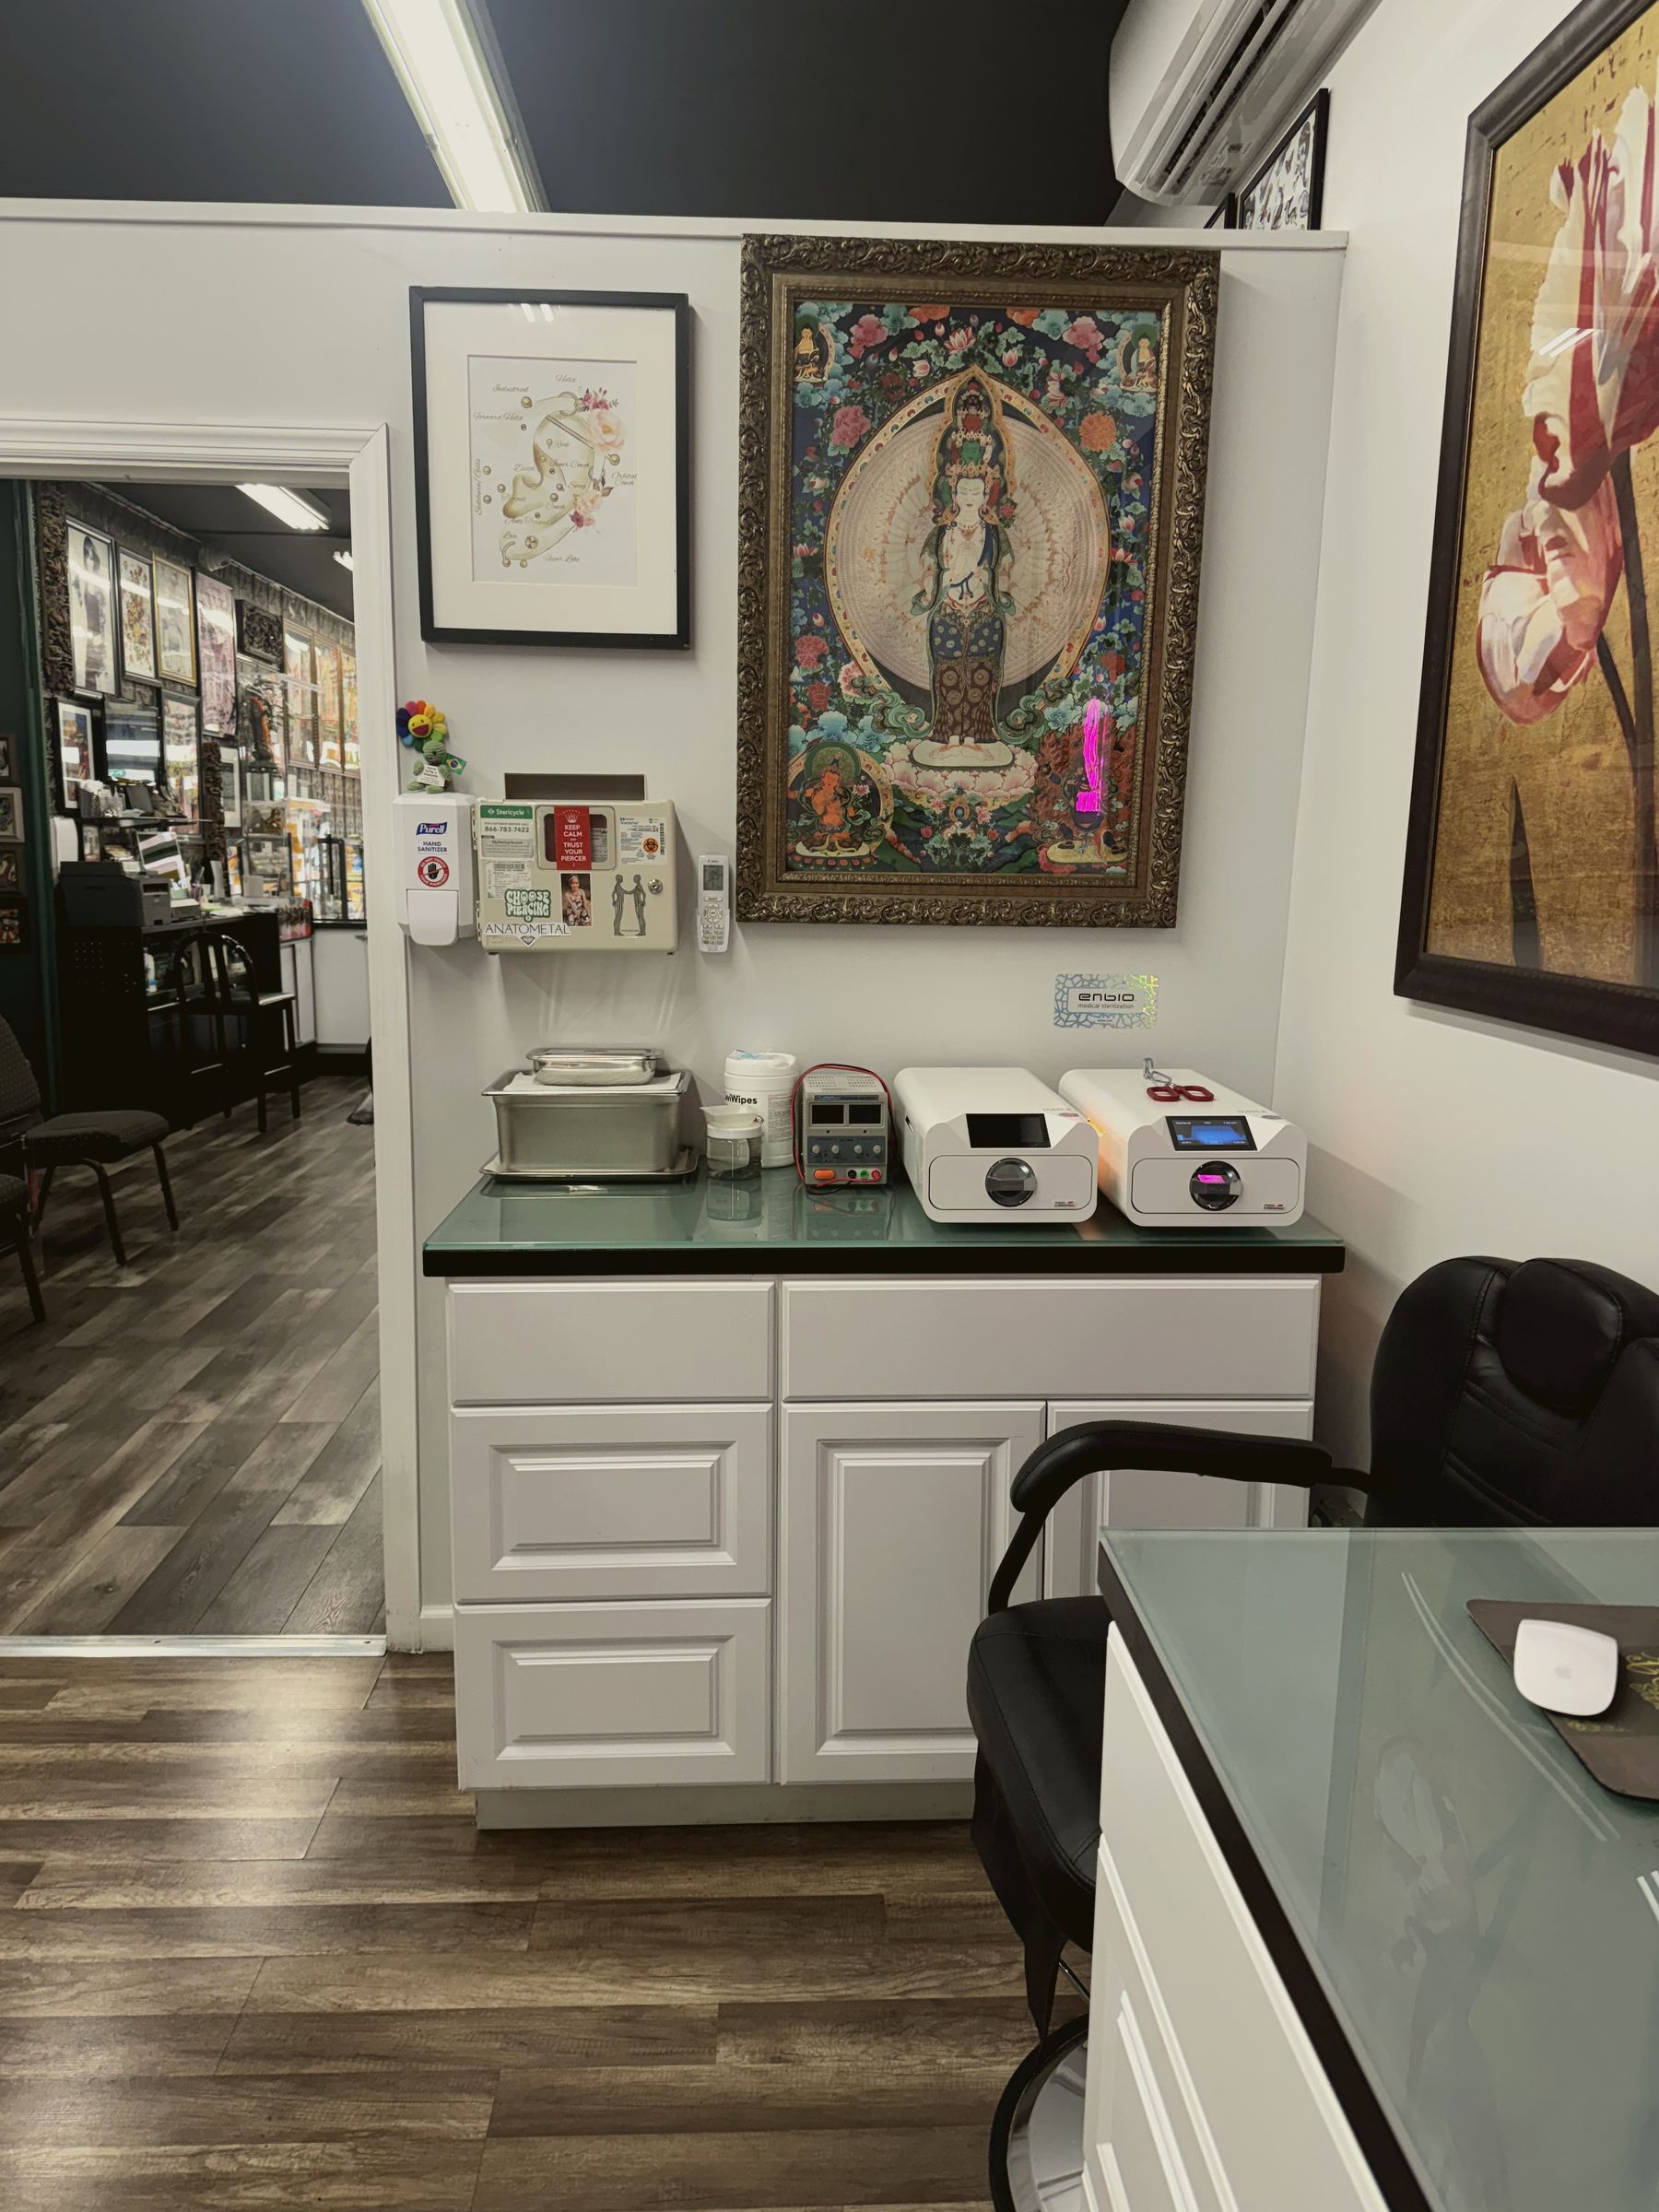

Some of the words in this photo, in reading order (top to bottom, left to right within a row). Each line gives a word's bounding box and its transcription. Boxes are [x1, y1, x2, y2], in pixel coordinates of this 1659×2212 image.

[496, 808, 525, 817] Stericycle
[505, 889, 550, 905] CHOOSE
[507, 902, 549, 917] PIERCING
[485, 924, 571, 935] ANATOMETAL
[1078, 993, 1135, 1002] enbio
